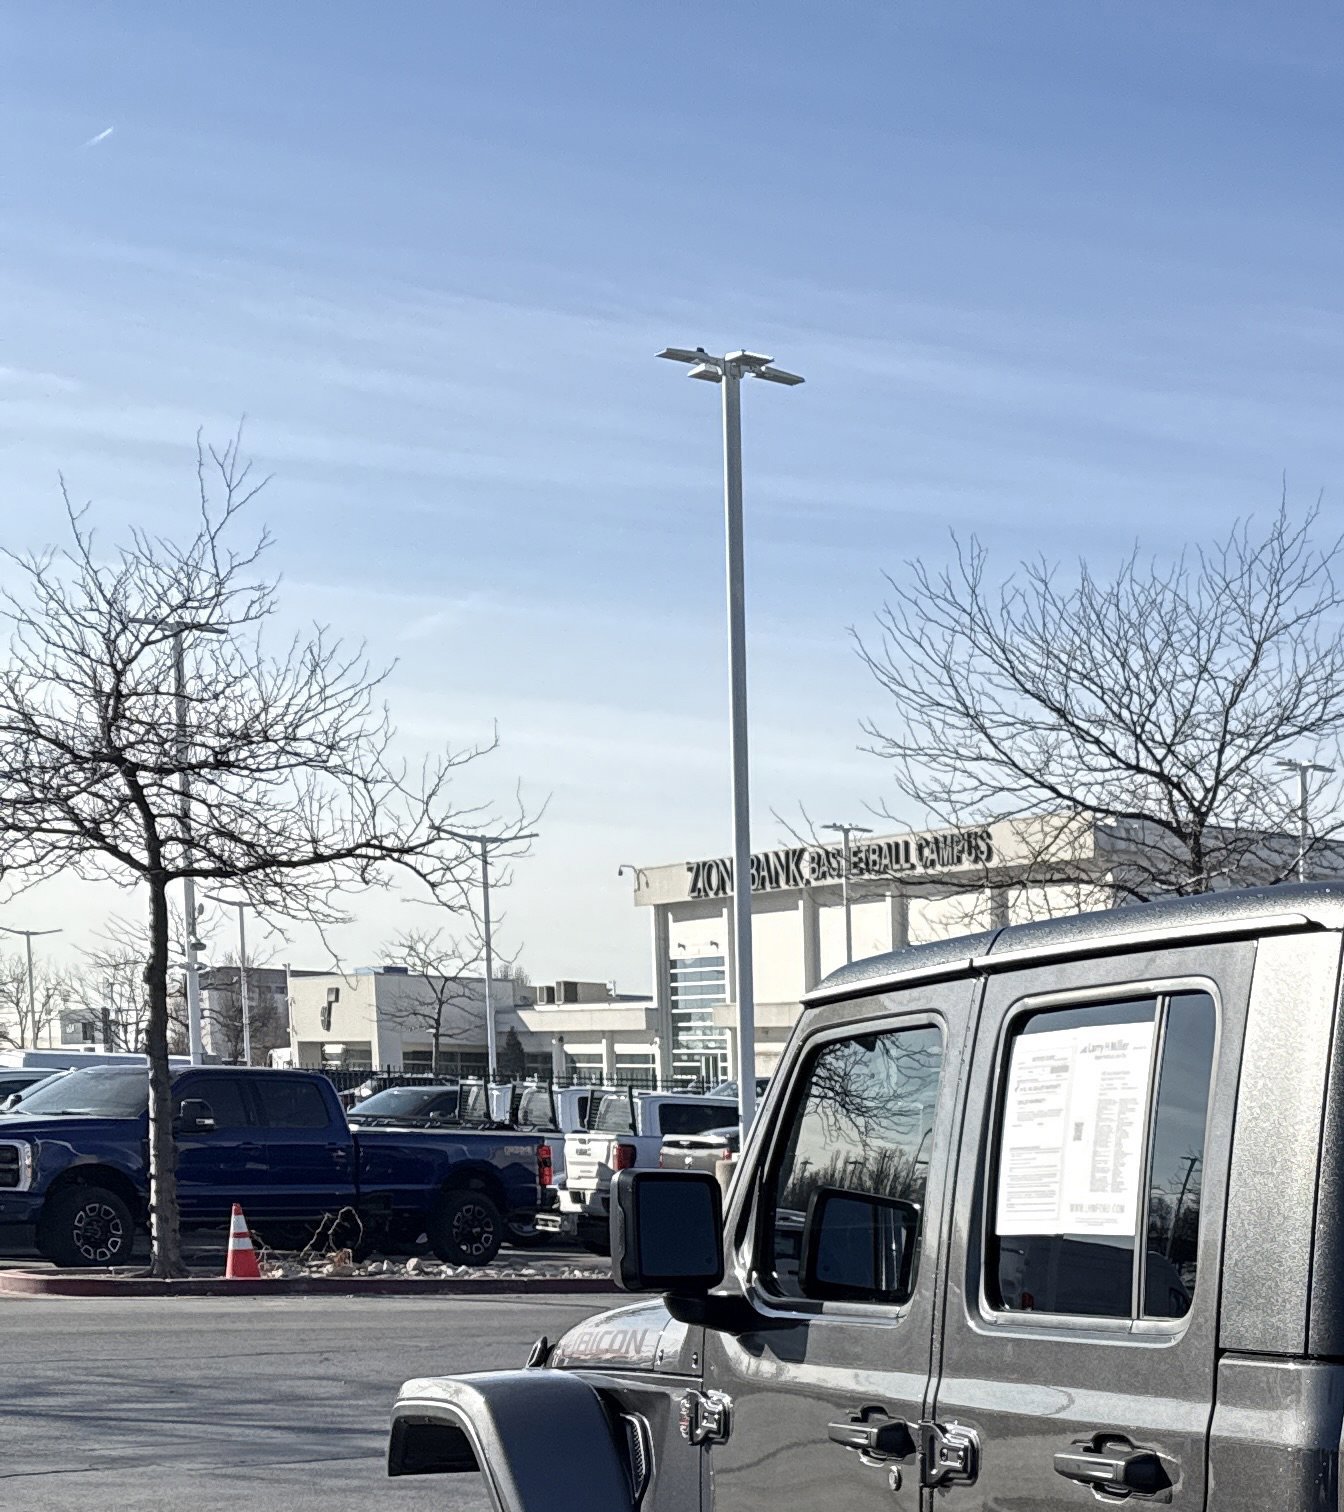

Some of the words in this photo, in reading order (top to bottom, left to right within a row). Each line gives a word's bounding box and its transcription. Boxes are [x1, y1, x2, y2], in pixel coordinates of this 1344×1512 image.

[685, 856, 737, 898] ZION
[915, 830, 995, 869] CAMPUS
[563, 1328, 650, 1357] BICON
